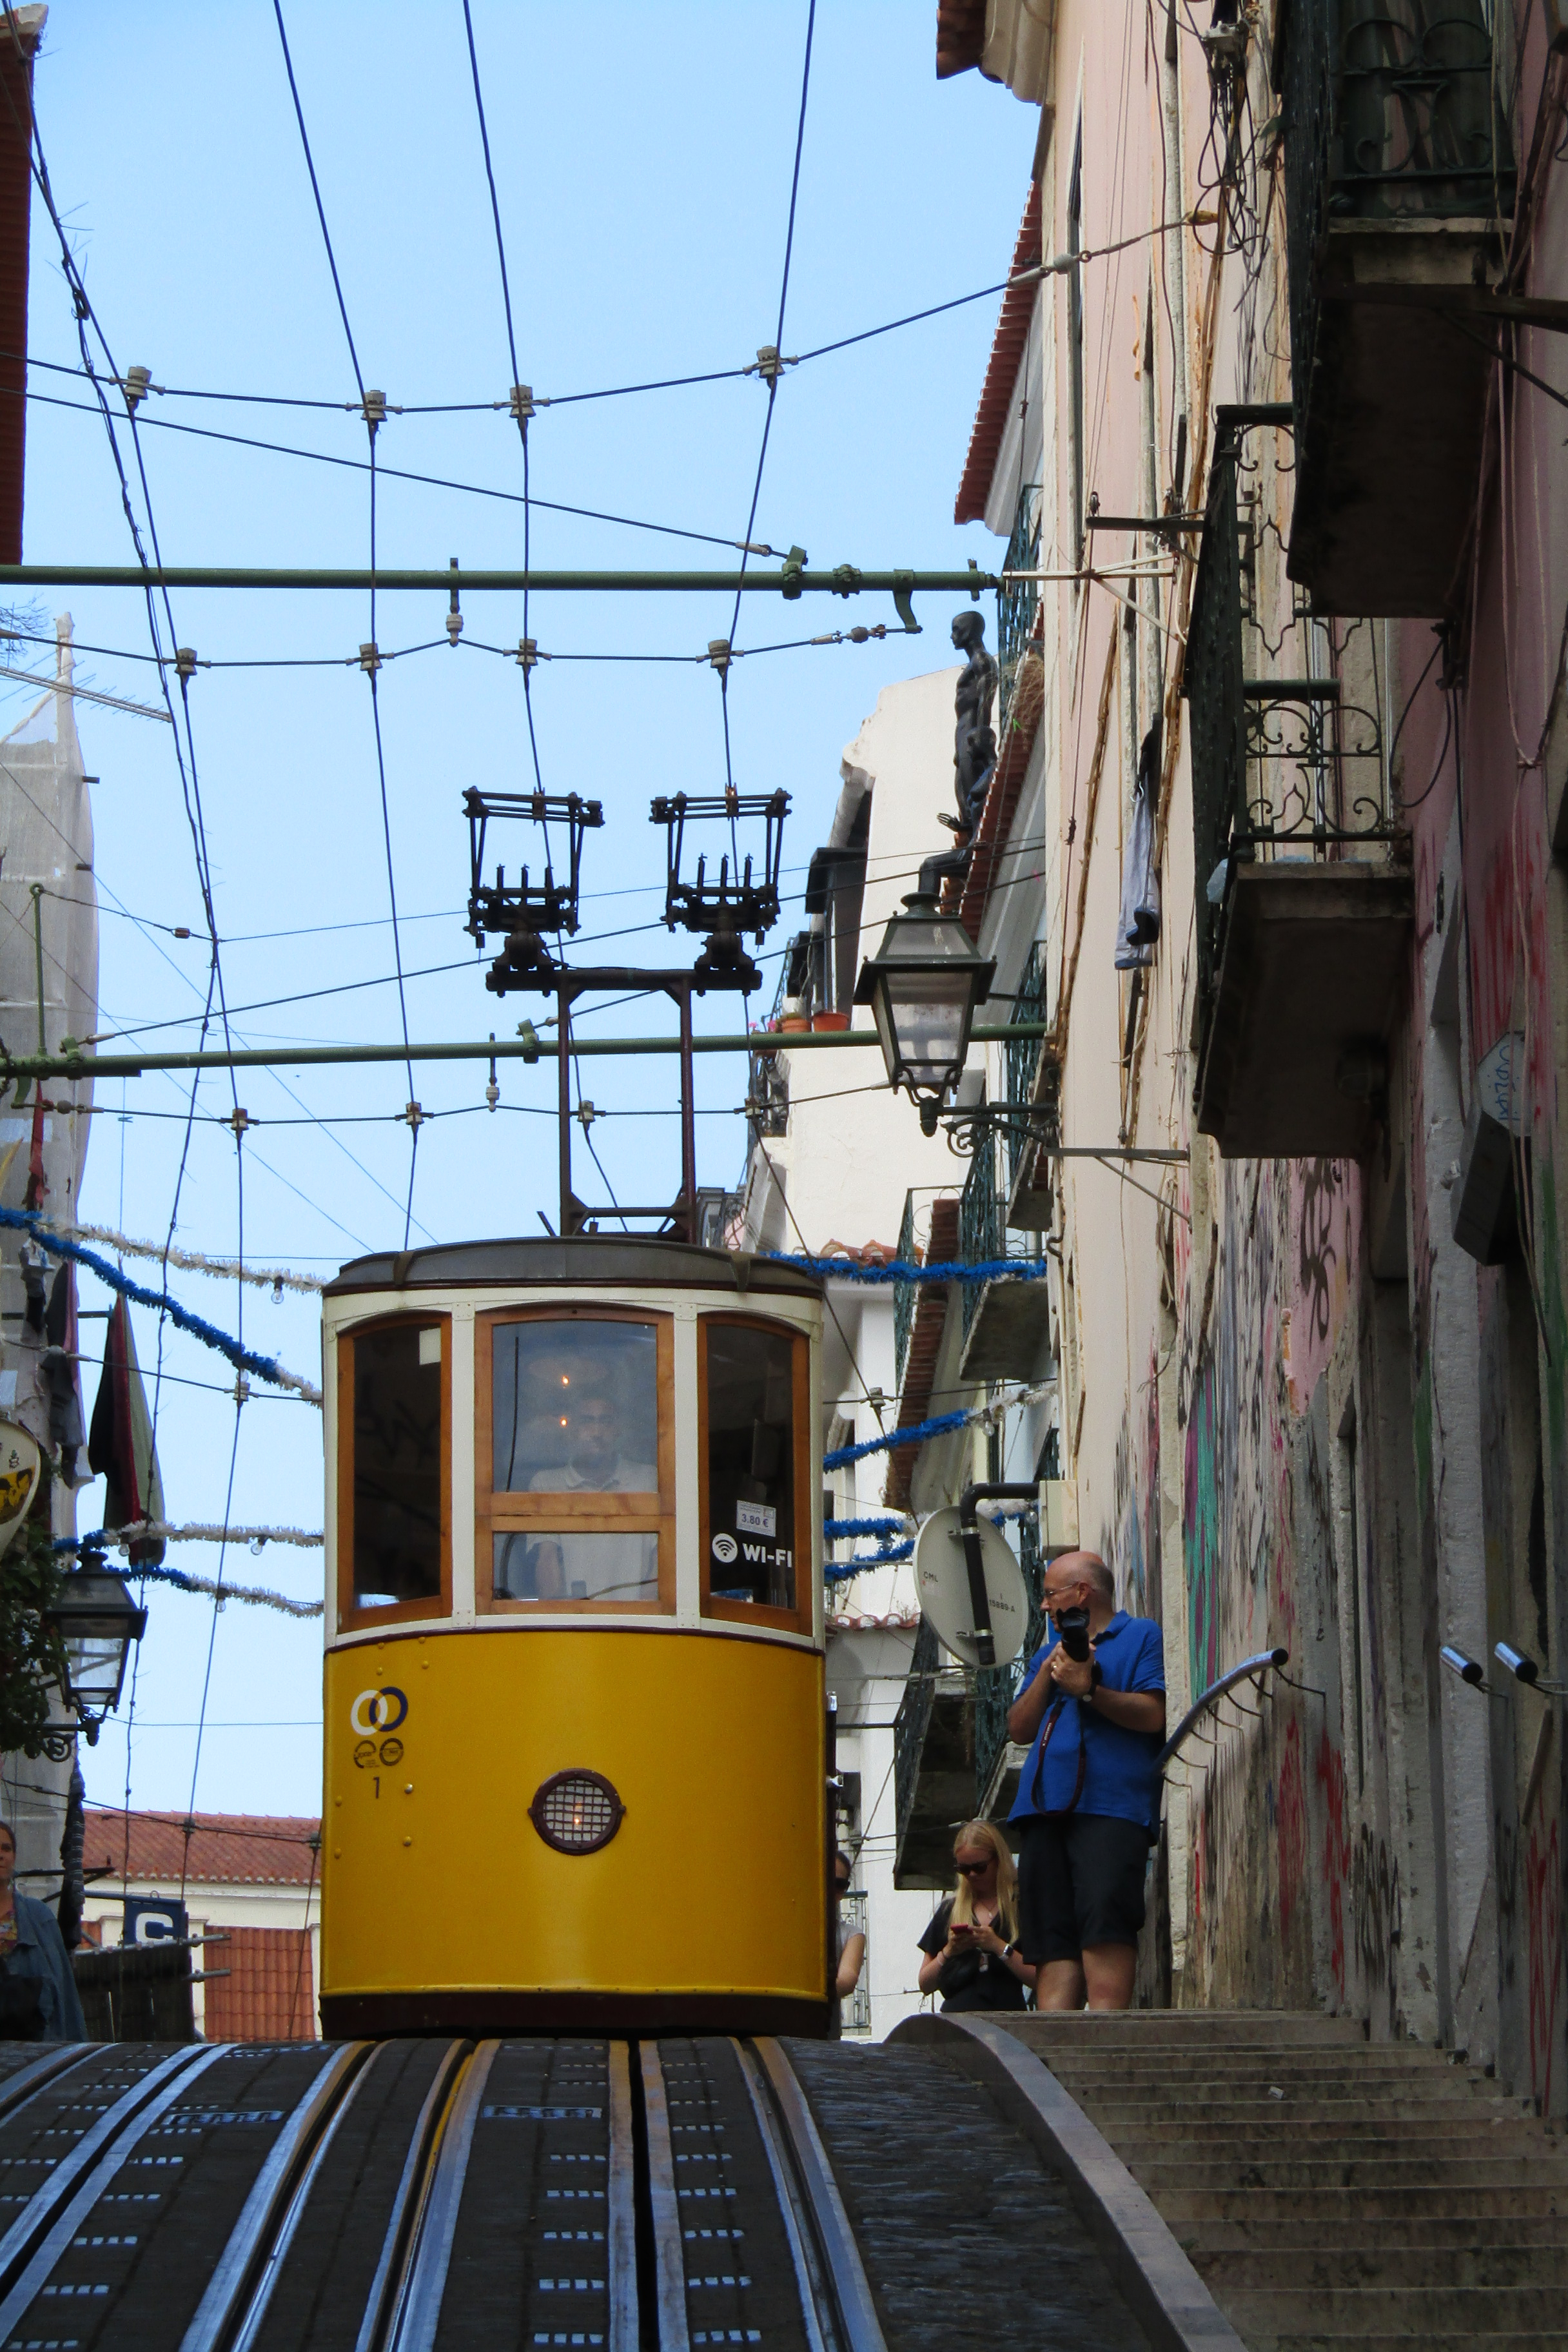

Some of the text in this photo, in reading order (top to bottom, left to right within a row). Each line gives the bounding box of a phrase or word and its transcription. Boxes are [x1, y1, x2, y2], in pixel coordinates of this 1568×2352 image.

[741, 1513, 769, 1527] 3.80 €
[743, 1543, 792, 1568] WI-FI
[923, 1571, 938, 1582] CML
[373, 1776, 380, 1799] 1
